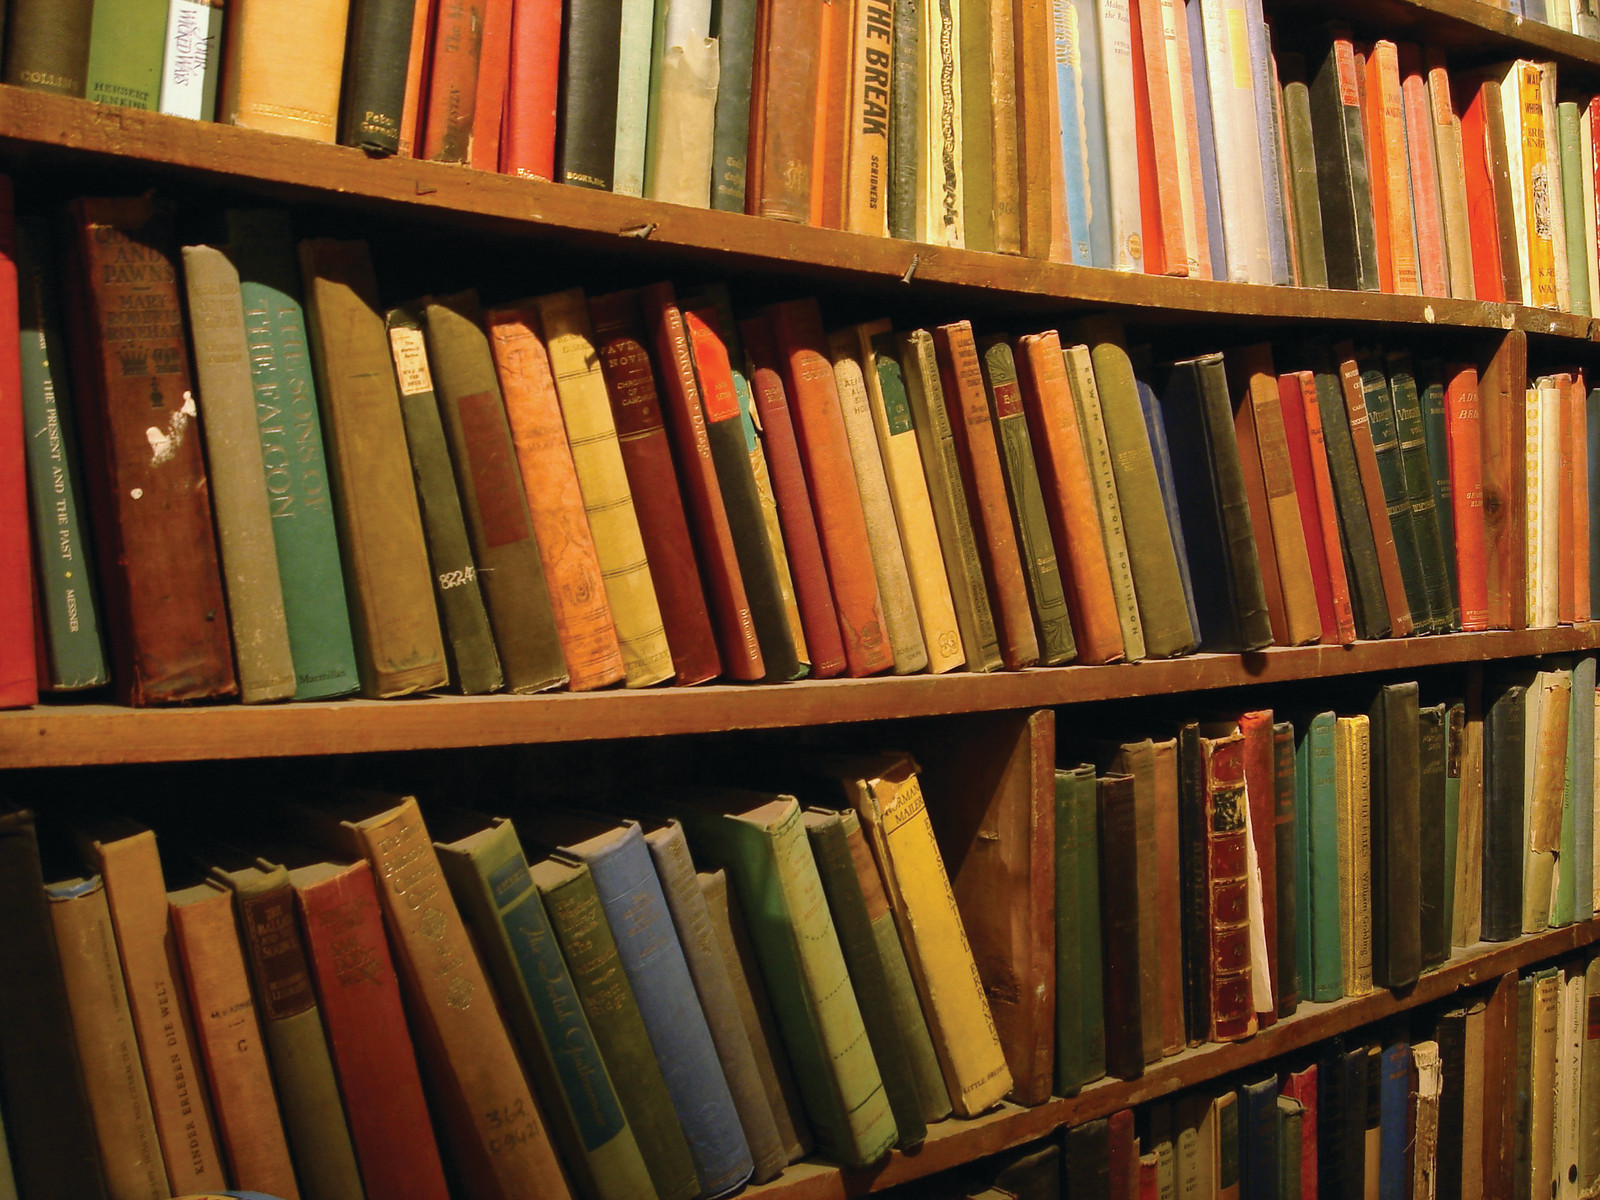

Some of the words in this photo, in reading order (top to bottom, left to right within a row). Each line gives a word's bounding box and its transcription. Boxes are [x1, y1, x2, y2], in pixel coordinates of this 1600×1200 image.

[175, 9, 198, 54] WICKED
[866, 0, 892, 45] THE
[173, 54, 191, 87] WAYS
[862, 46, 891, 140] BREAK
[869, 154, 880, 210] SCRIBNERS
[102, 264, 175, 285] PAWNS
[118, 294, 168, 309] MARY
[667, 307, 682, 330] HE
[674, 336, 698, 400] MARTYR
[43, 380, 56, 404] THE
[47, 407, 62, 461] PRESENT
[289, 376, 315, 465] SONS
[255, 383, 297, 520] FALCON
[52, 465, 65, 494] AND
[301, 466, 327, 517] OF
[1084, 366, 1099, 422] EDWIN
[1096, 437, 1122, 536] ARLINGTON
[1118, 550, 1139, 636] ROBINSON
[55, 498, 69, 526] THE
[59, 529, 73, 563] PAST
[65, 588, 80, 634] MESSNER
[1361, 734, 1370, 768] LORD
[895, 794, 926, 825] MAILER
[1361, 825, 1370, 859] FLIES
[1361, 870, 1370, 916] William
[922, 816, 971, 955] EXISTENTIAL
[969, 962, 999, 1047] ERRANDS
[1360, 917, 1370, 957] Golding
[154, 979, 170, 1019] WELT
[162, 1021, 178, 1047] DIE
[171, 1053, 193, 1116] ERLEBEN
[185, 1122, 205, 1177] KINDER
